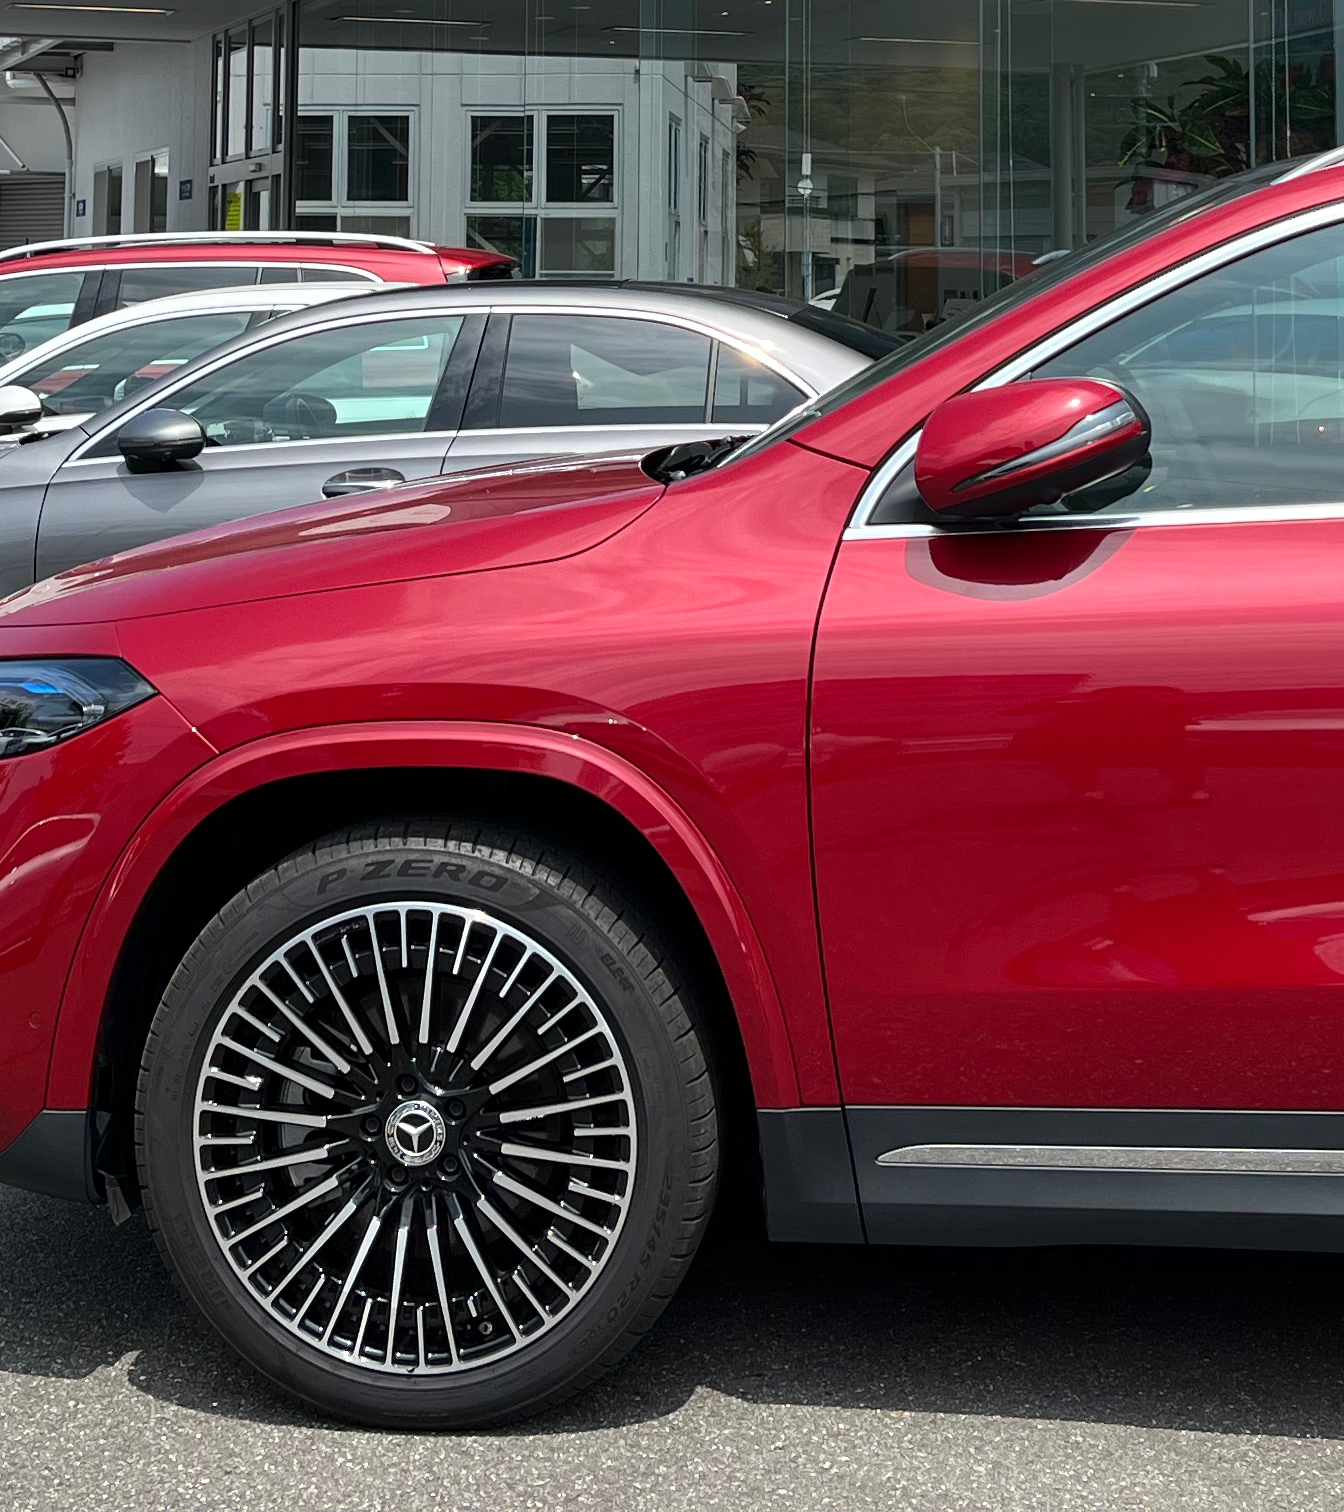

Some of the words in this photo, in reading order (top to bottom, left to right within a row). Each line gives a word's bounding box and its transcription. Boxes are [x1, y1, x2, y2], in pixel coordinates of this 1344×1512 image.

[316, 867, 348, 896] P
[359, 858, 510, 894] ZERO
[640, 1174, 674, 1271] 235/45
[606, 1271, 642, 1324] R20
